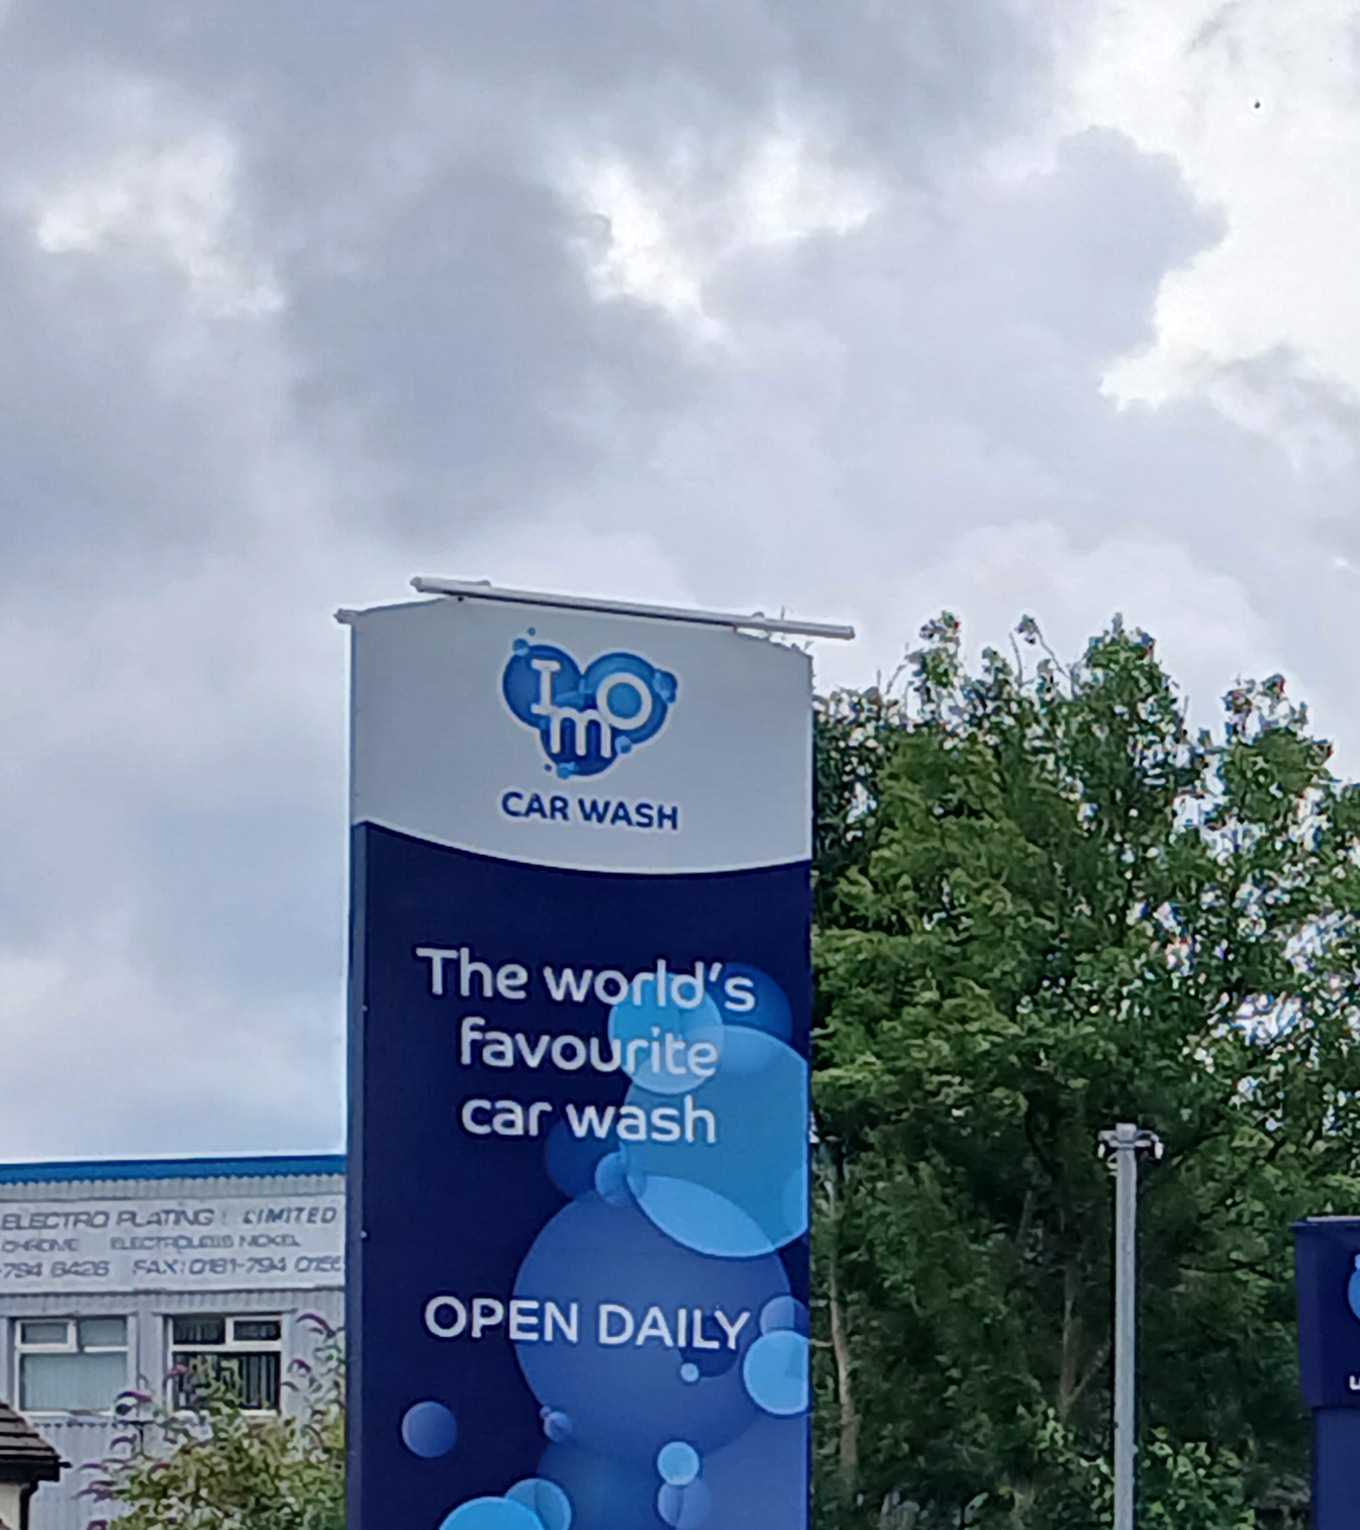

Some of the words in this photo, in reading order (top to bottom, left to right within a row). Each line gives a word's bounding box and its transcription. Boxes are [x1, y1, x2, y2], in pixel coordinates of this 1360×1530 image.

[501, 791, 570, 822] CAR
[578, 797, 679, 831] WASH
[416, 946, 529, 1000] The
[543, 960, 756, 1012] world's
[460, 1016, 719, 1077] favourite
[461, 1097, 549, 1137] car
[566, 1094, 717, 1144] wash
[1, 1210, 110, 1231] ELECTRO
[116, 1208, 215, 1228] PLATING
[243, 1206, 337, 1225] LIMITED
[424, 1295, 579, 1344] OPEN
[598, 1304, 751, 1351] DAILY
